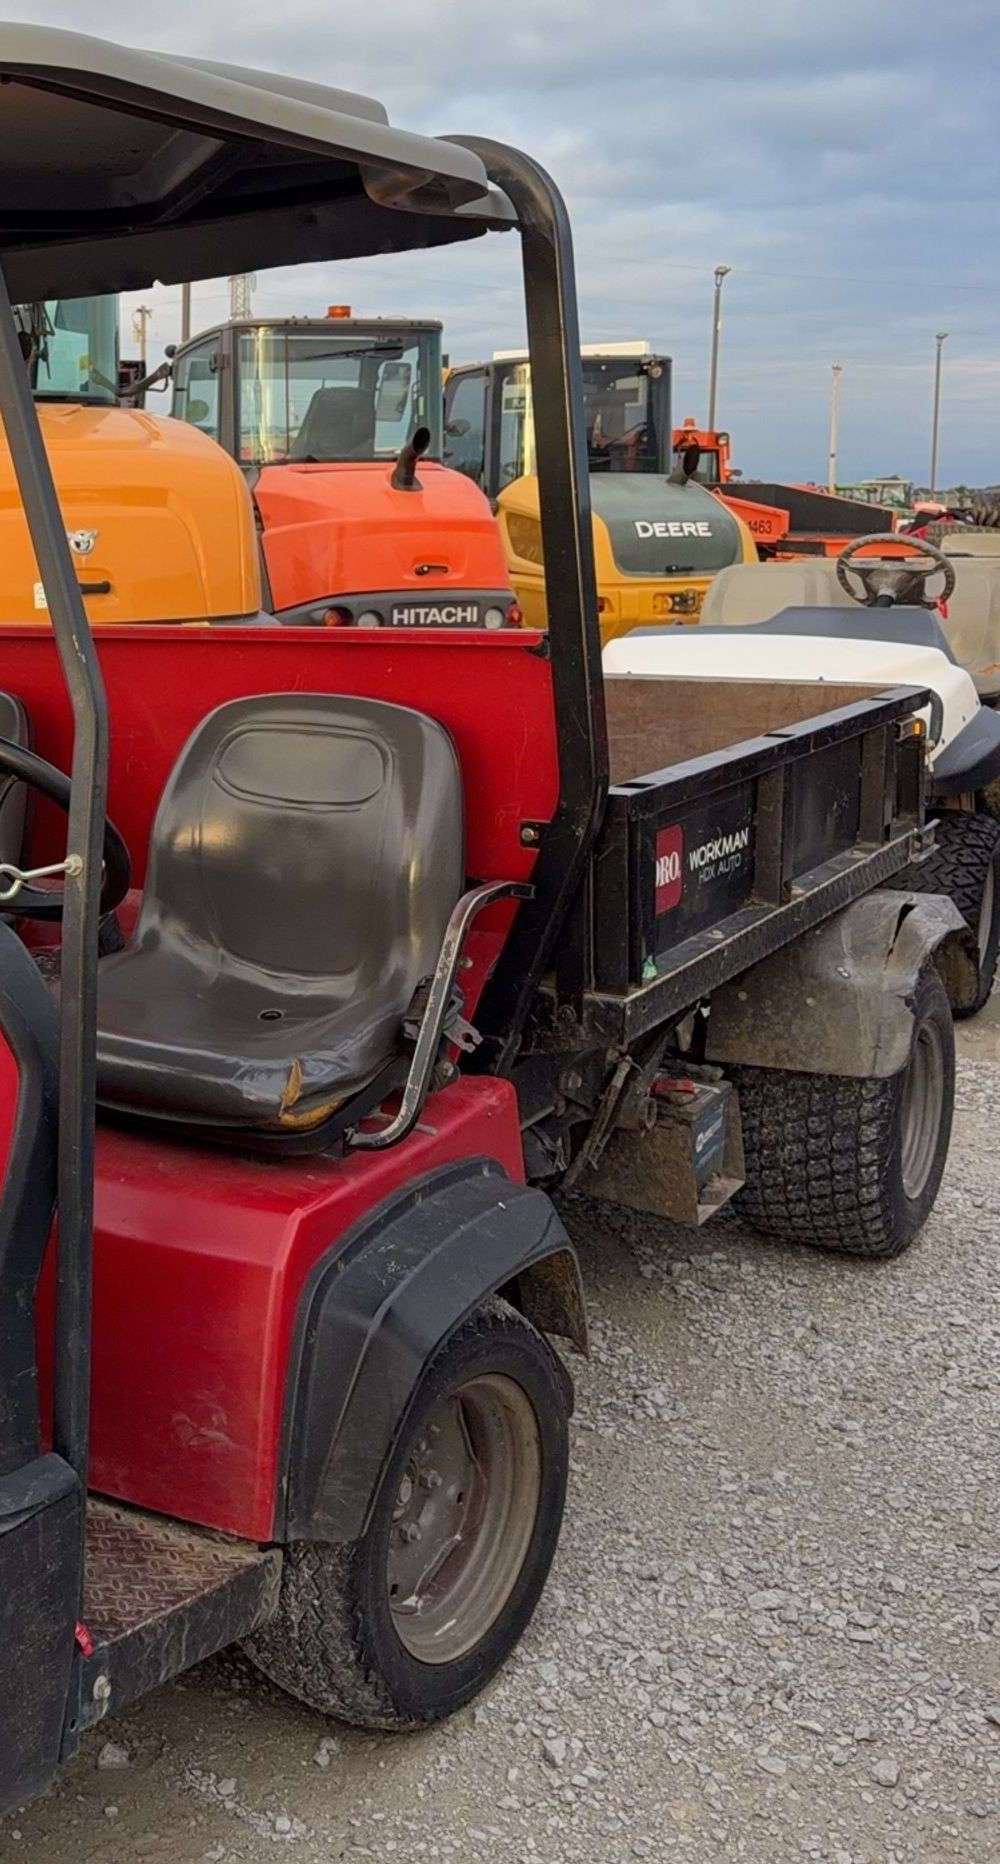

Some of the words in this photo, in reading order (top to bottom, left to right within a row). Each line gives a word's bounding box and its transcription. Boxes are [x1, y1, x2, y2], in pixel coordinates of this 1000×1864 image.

[634, 521, 713, 538] DEERE
[392, 606, 478, 625] HITACHI
[689, 827, 750, 872] WORKMAN
